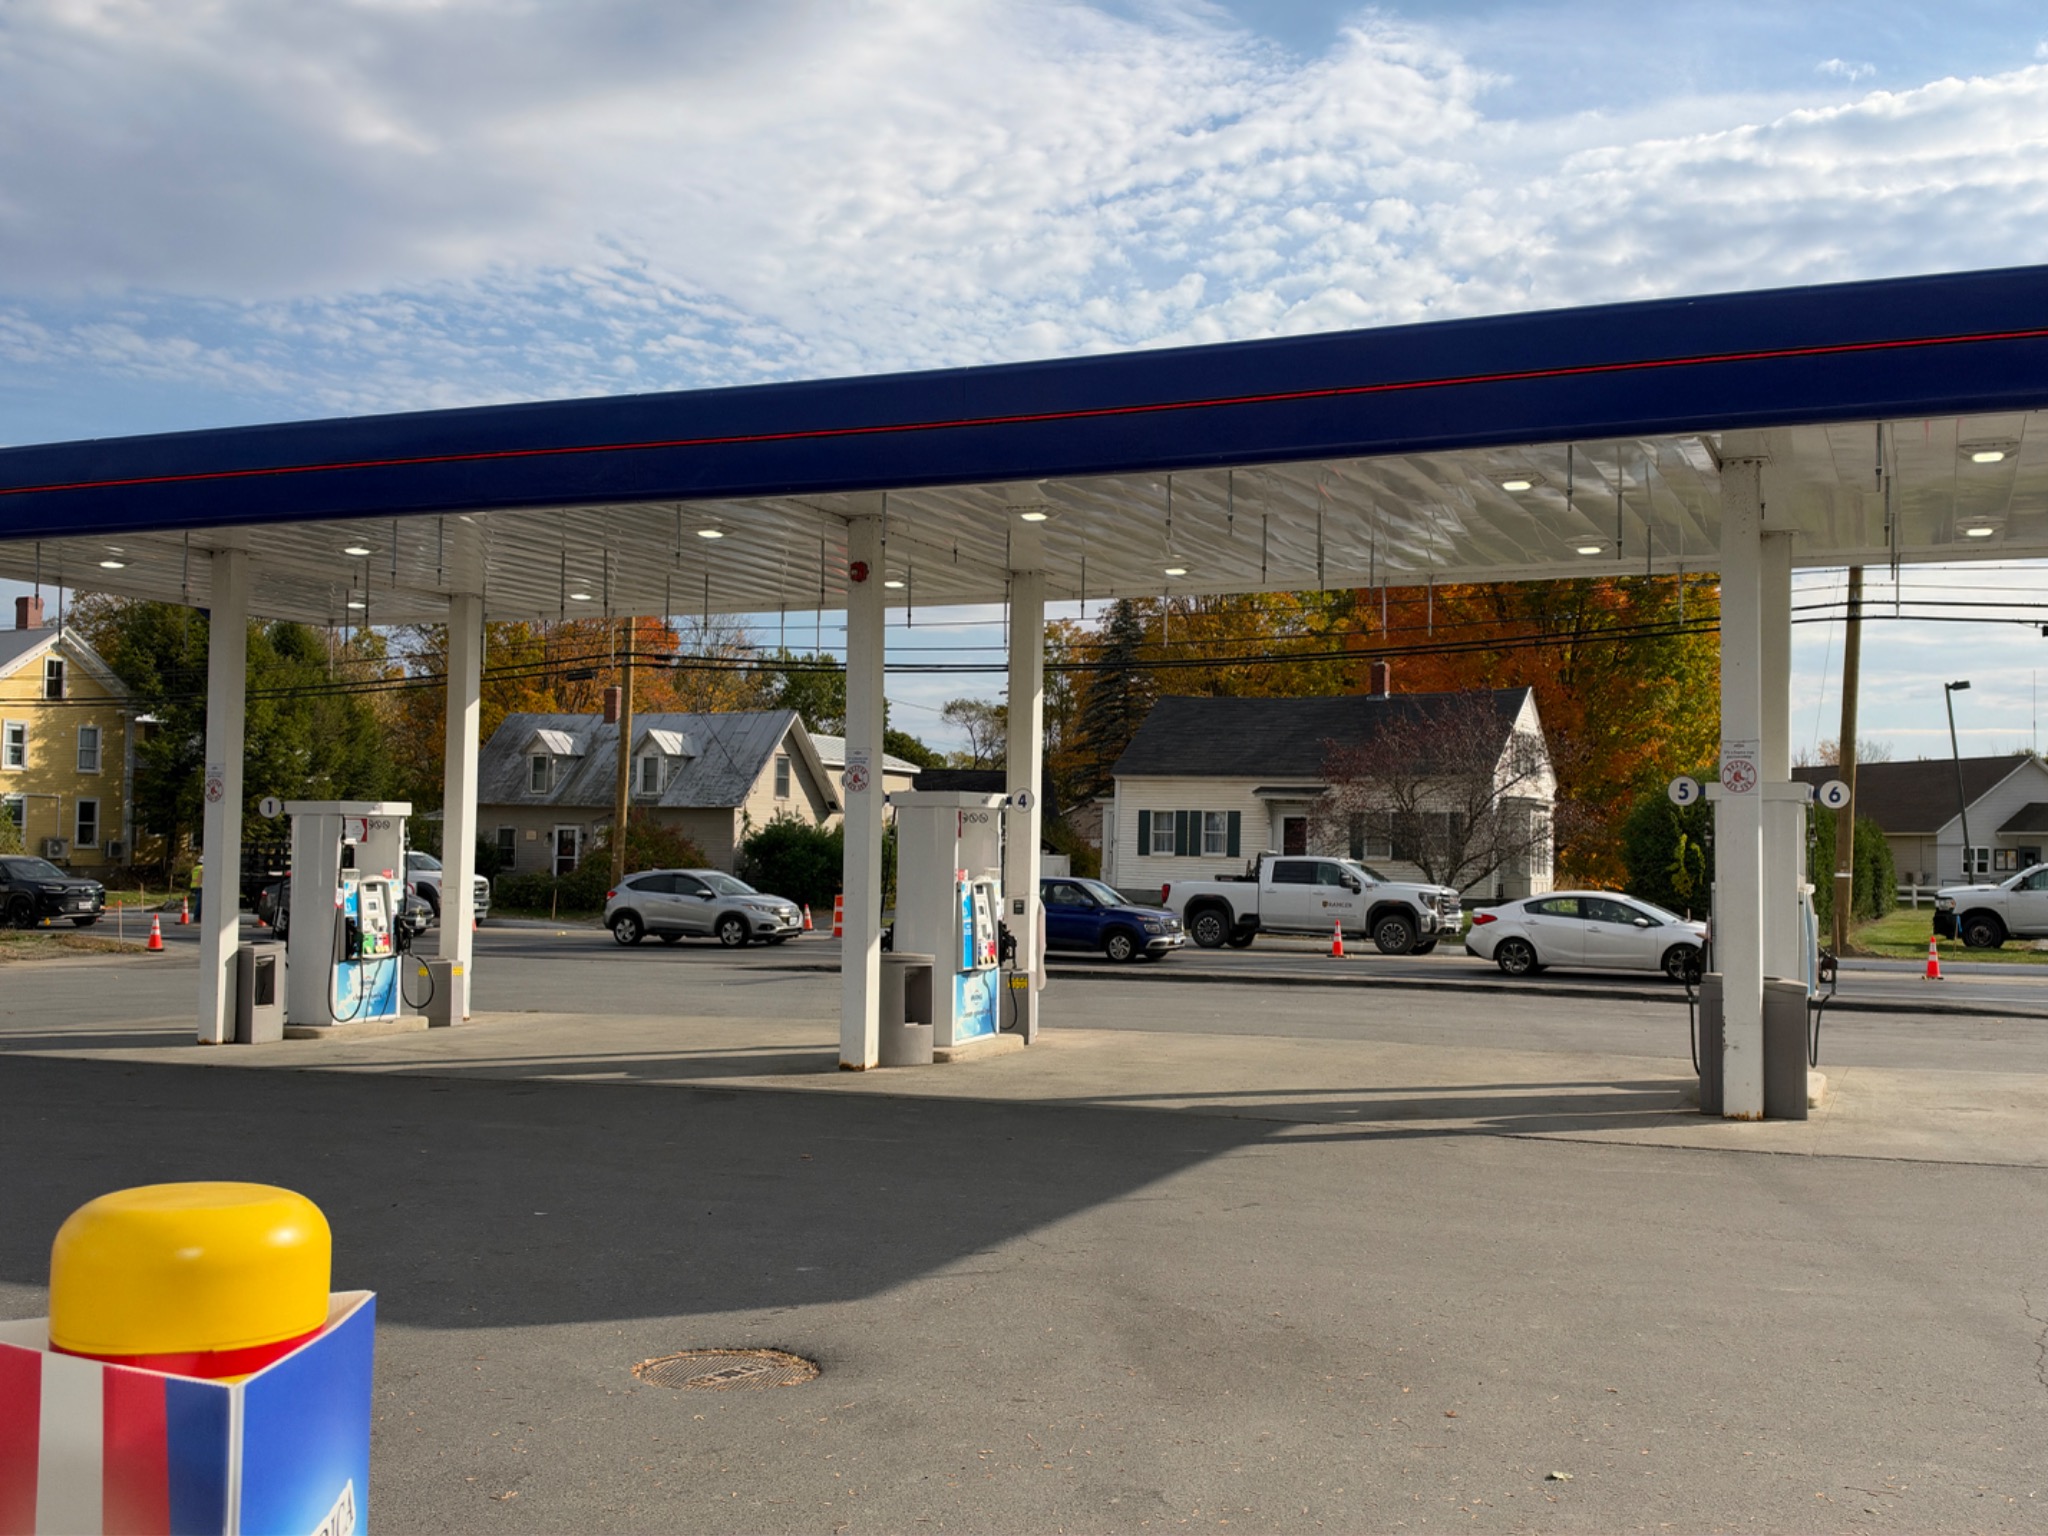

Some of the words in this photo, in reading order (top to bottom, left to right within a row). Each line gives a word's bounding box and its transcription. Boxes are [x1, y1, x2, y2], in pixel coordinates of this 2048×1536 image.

[1678, 783, 1689, 800] 5
[1829, 786, 1841, 803] 6
[267, 801, 272, 814] 1
[1018, 794, 1027, 808] 4
